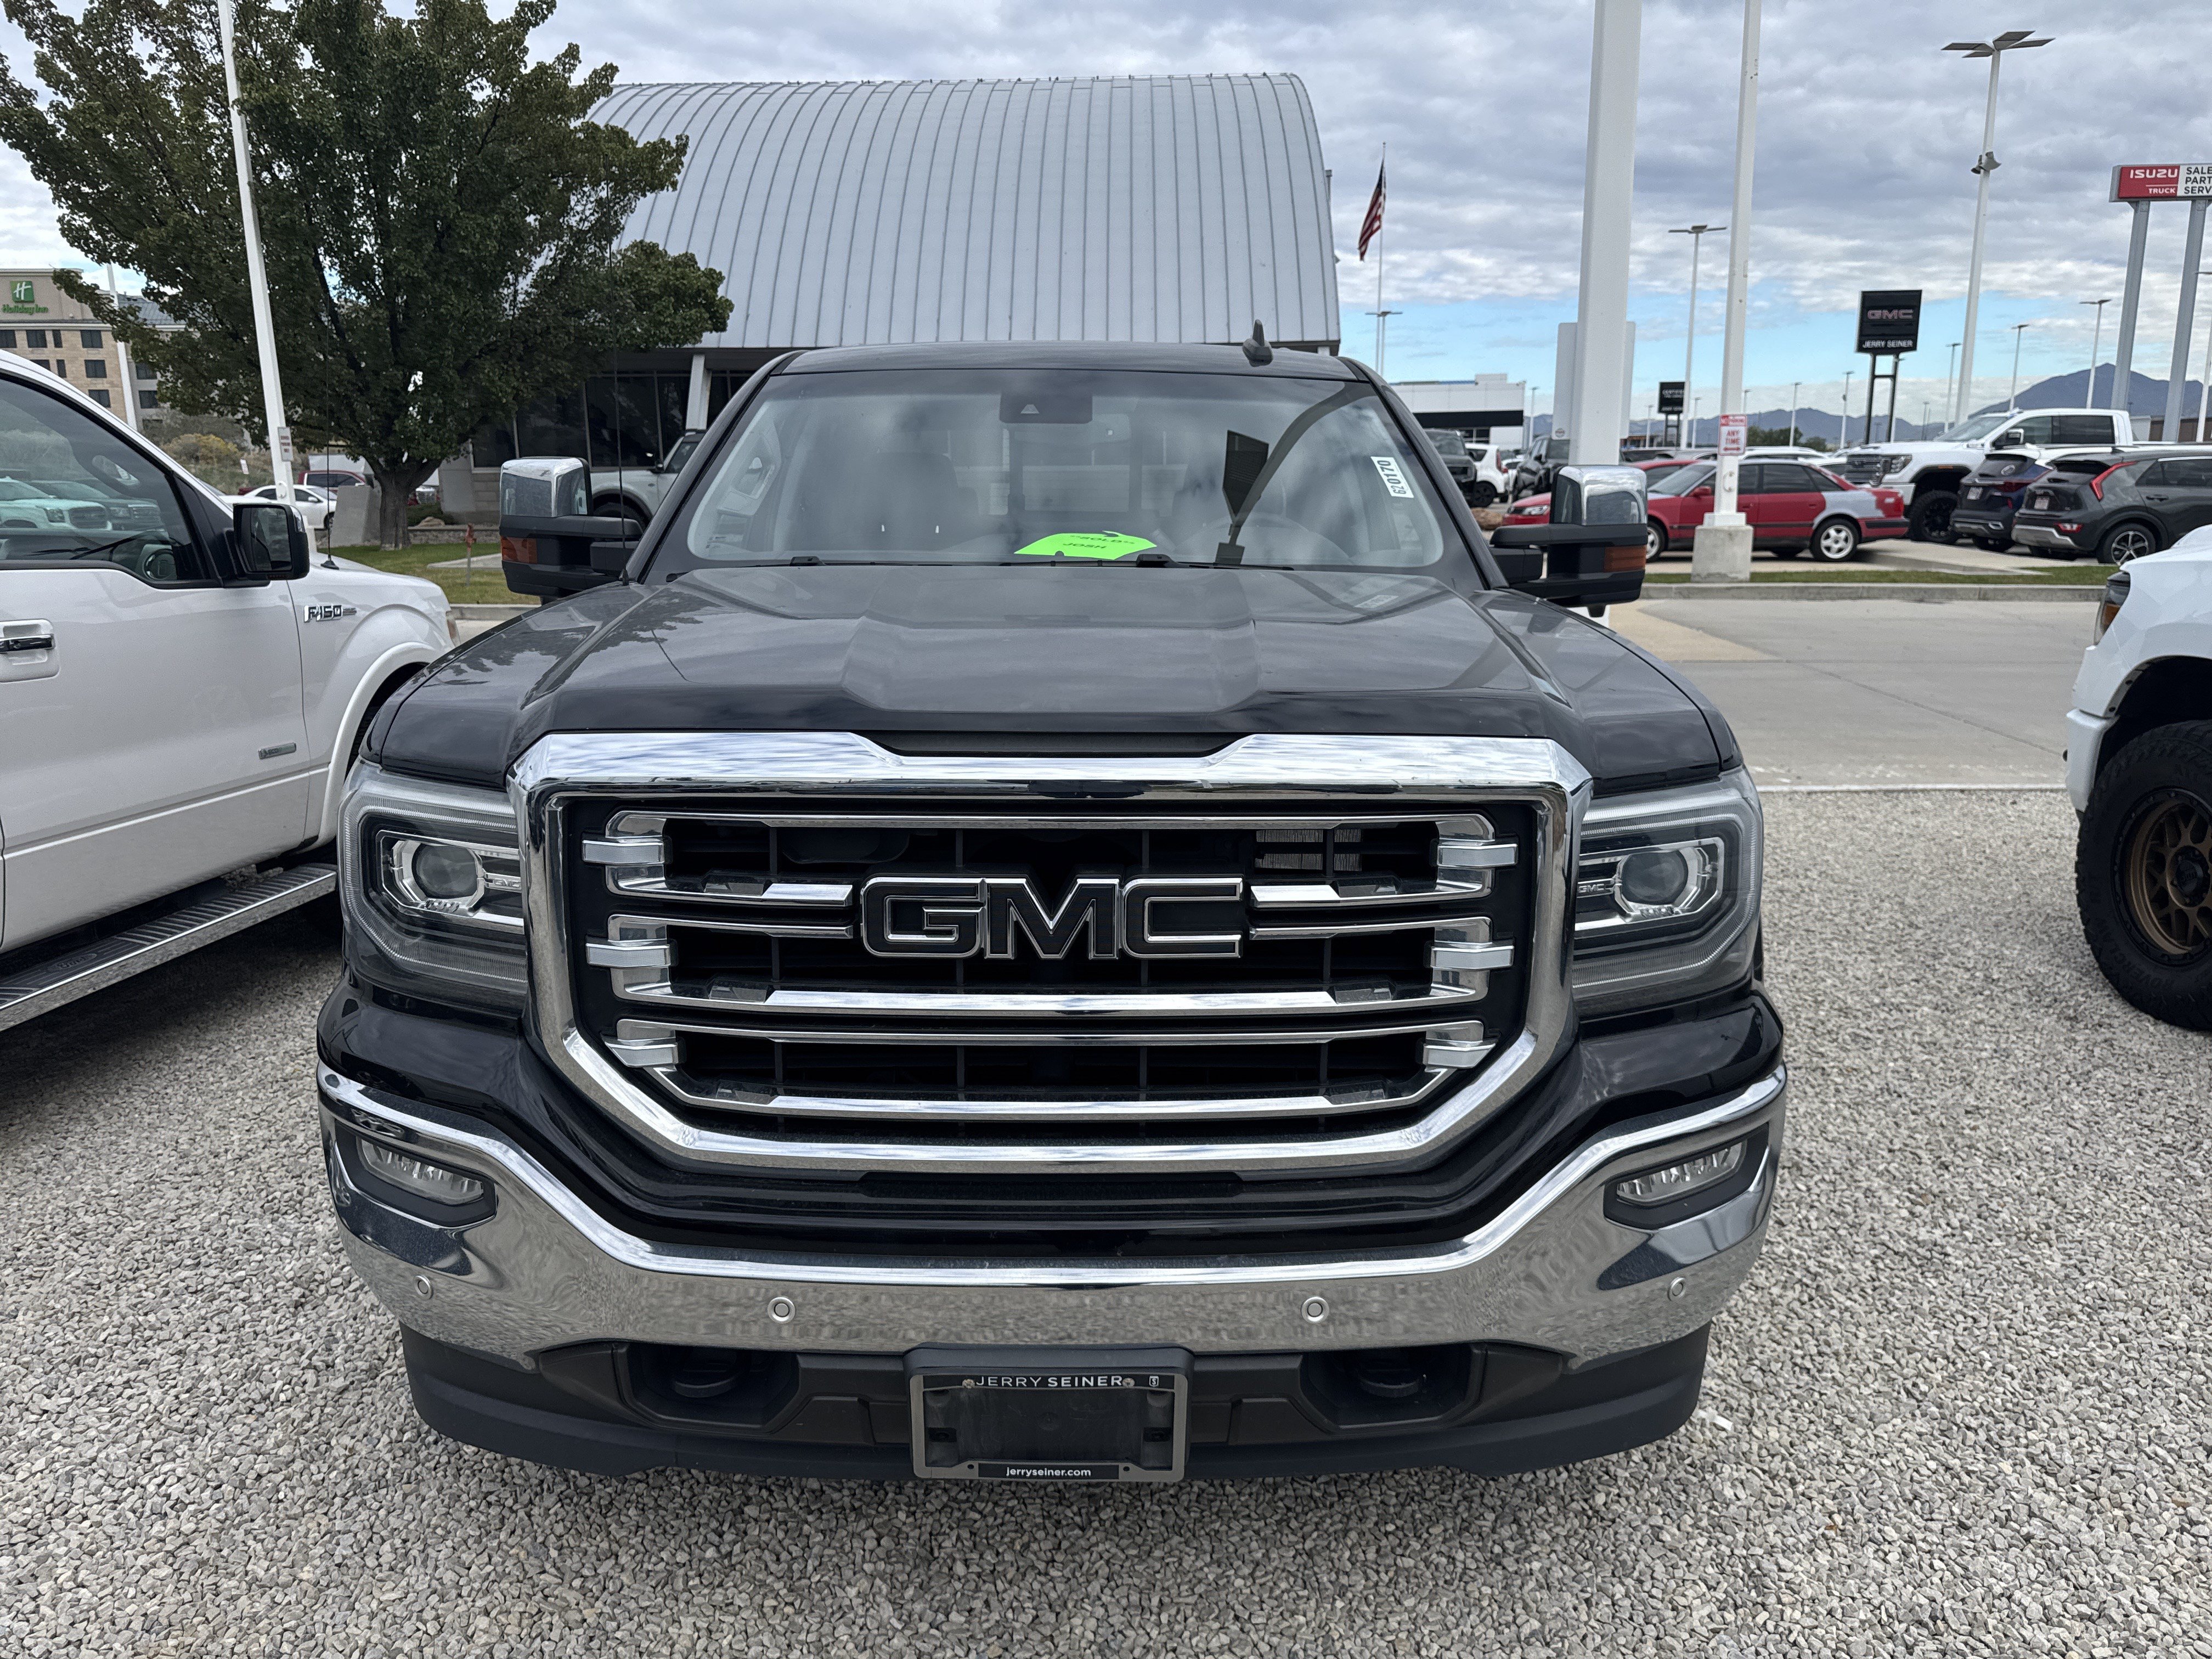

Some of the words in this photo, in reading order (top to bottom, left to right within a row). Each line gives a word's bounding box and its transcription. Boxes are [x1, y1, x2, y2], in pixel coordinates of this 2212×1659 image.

[2130, 168, 2178, 179] ISUZU
[2, 303, 35, 315] Holiday
[35, 303, 49, 313] Inn
[1867, 309, 1914, 320] GMC
[1862, 340, 1886, 348] JERRY
[1887, 339, 1914, 348] SEINER
[1578, 884, 1604, 893] GMC
[861, 876, 1243, 960] GMC
[976, 1376, 1042, 1387] JERRY
[1047, 1375, 1122, 1387] SEINER
[1006, 1467, 1091, 1477] jerryseiner.com
